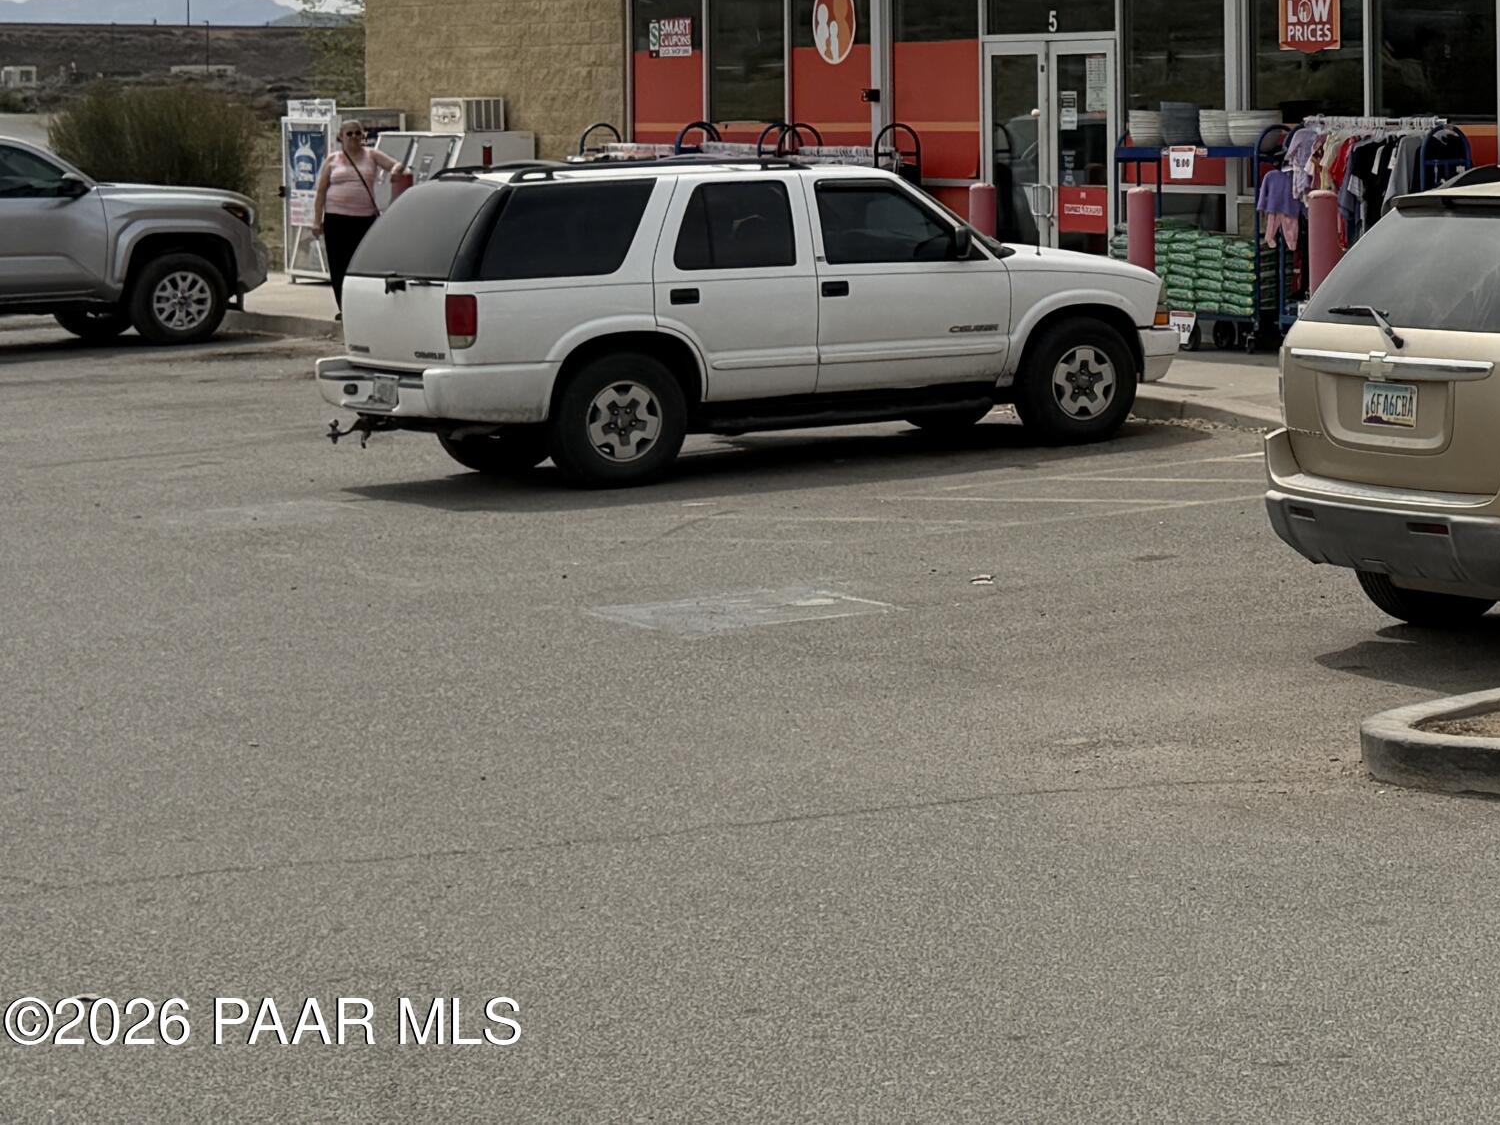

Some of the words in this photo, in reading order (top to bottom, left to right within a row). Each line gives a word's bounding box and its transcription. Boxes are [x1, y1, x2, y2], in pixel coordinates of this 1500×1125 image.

[1048, 10, 1058, 32] 5
[1287, 0, 1331, 23] LOW
[660, 18, 691, 35] SMART
[1287, 24, 1332, 42] PRICES
